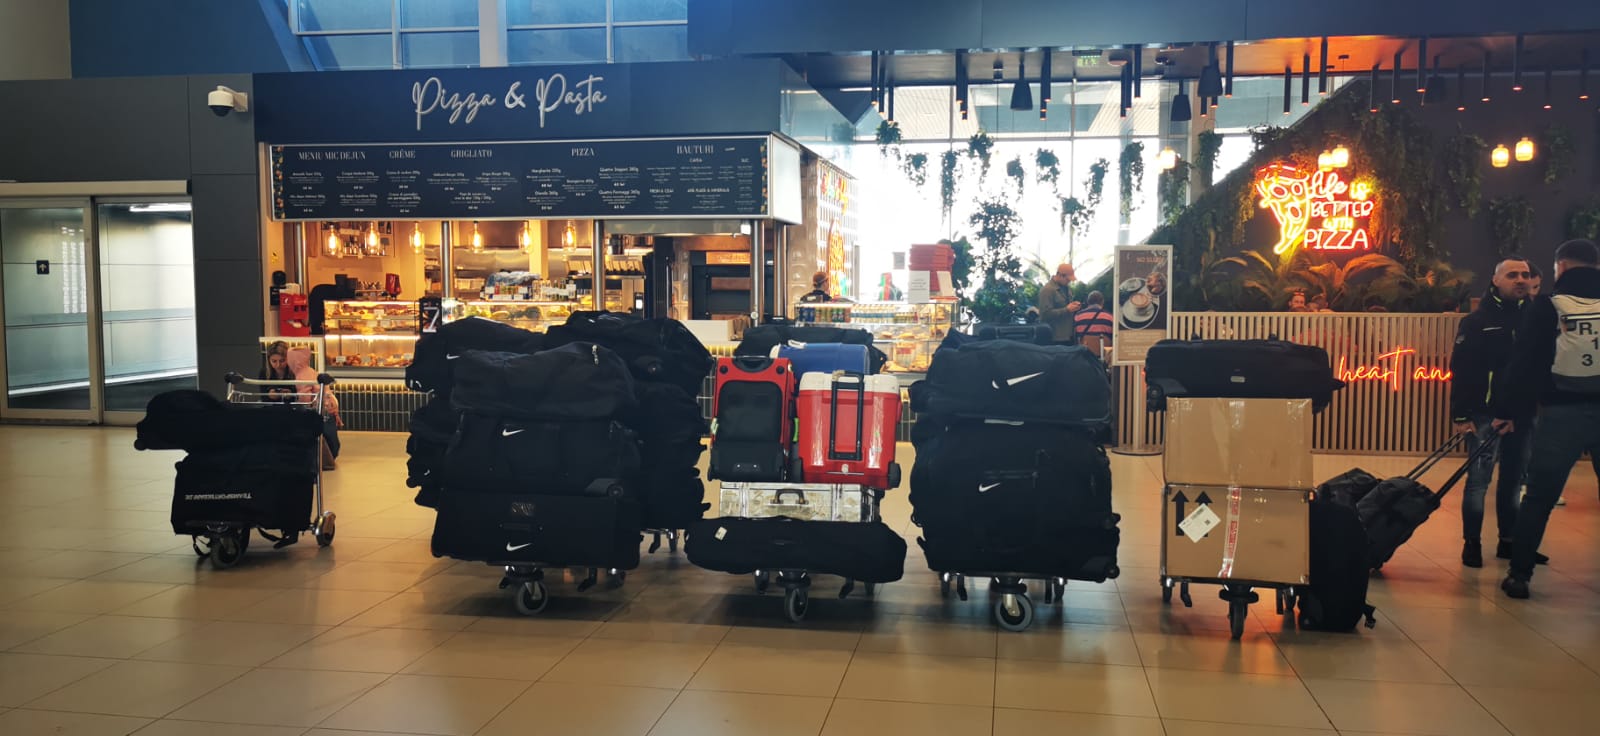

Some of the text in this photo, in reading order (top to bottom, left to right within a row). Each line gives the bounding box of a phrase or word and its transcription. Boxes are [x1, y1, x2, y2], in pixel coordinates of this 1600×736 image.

[412, 73, 607, 131] Pizza & Pasta
[325, 151, 339, 160] MIC
[340, 151, 366, 160] DEJUN
[450, 149, 493, 158] GRIGLIATO
[571, 148, 595, 157] PIZZA
[1311, 201, 1374, 217] BETTER
[1303, 229, 1368, 249] PIZZA
[1581, 354, 1593, 366] 3
[1338, 346, 1417, 390] heart
